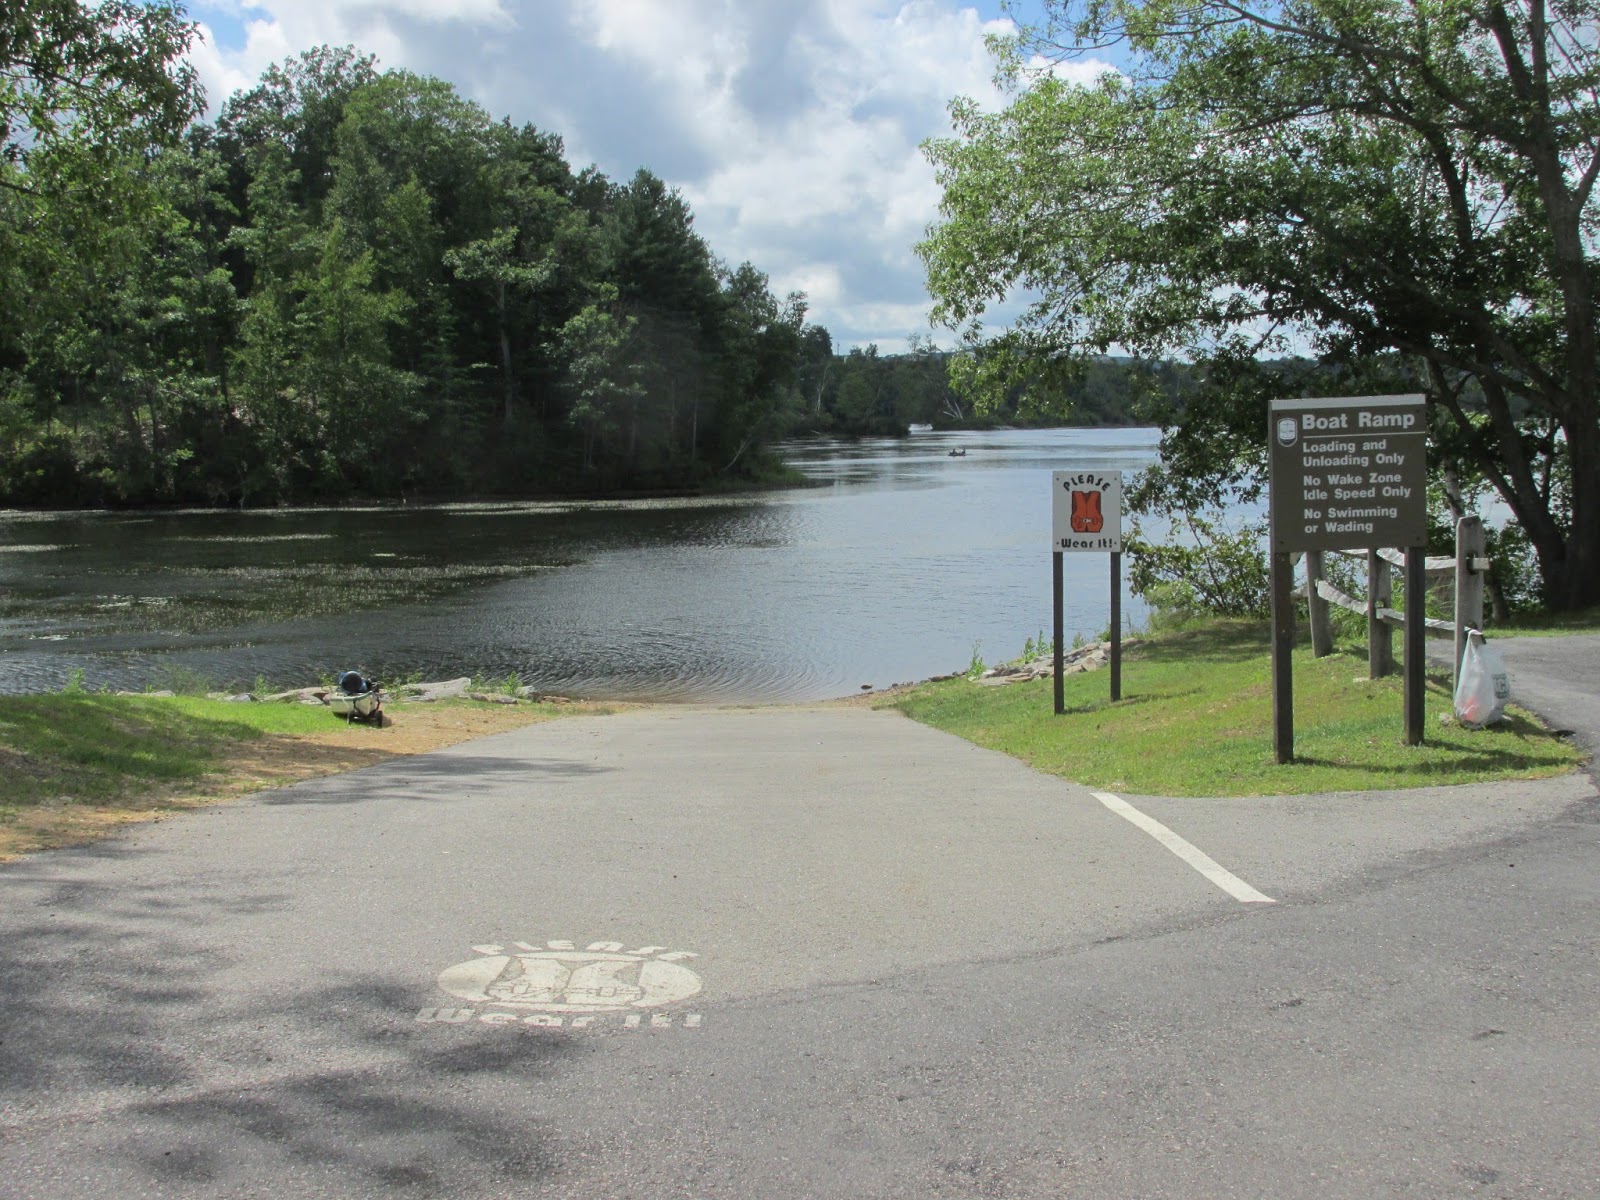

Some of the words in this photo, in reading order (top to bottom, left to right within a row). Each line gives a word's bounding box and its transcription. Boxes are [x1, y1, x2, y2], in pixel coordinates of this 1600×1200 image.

[1302, 413, 1348, 430] Boat
[1358, 412, 1415, 429] Ramp
[1303, 440, 1356, 453] Loading
[1362, 439, 1387, 450] and
[1303, 454, 1369, 467] Unloading
[1375, 453, 1405, 465] Only
[1063, 474, 1111, 491] PLEASE
[1303, 475, 1321, 486] No
[1327, 474, 1362, 485] Wake
[1369, 473, 1402, 484] Zone
[1304, 489, 1328, 500] Idle
[1334, 487, 1376, 501] Speed
[1382, 486, 1411, 498] Only
[1304, 508, 1321, 519] No
[1328, 506, 1397, 519] Swimming
[1304, 524, 1318, 534] or
[1325, 521, 1373, 534] Wading
[1061, 538, 1093, 548] Wear
[1098, 538, 1112, 548] It!
[415, 1008, 595, 1028] Wear
